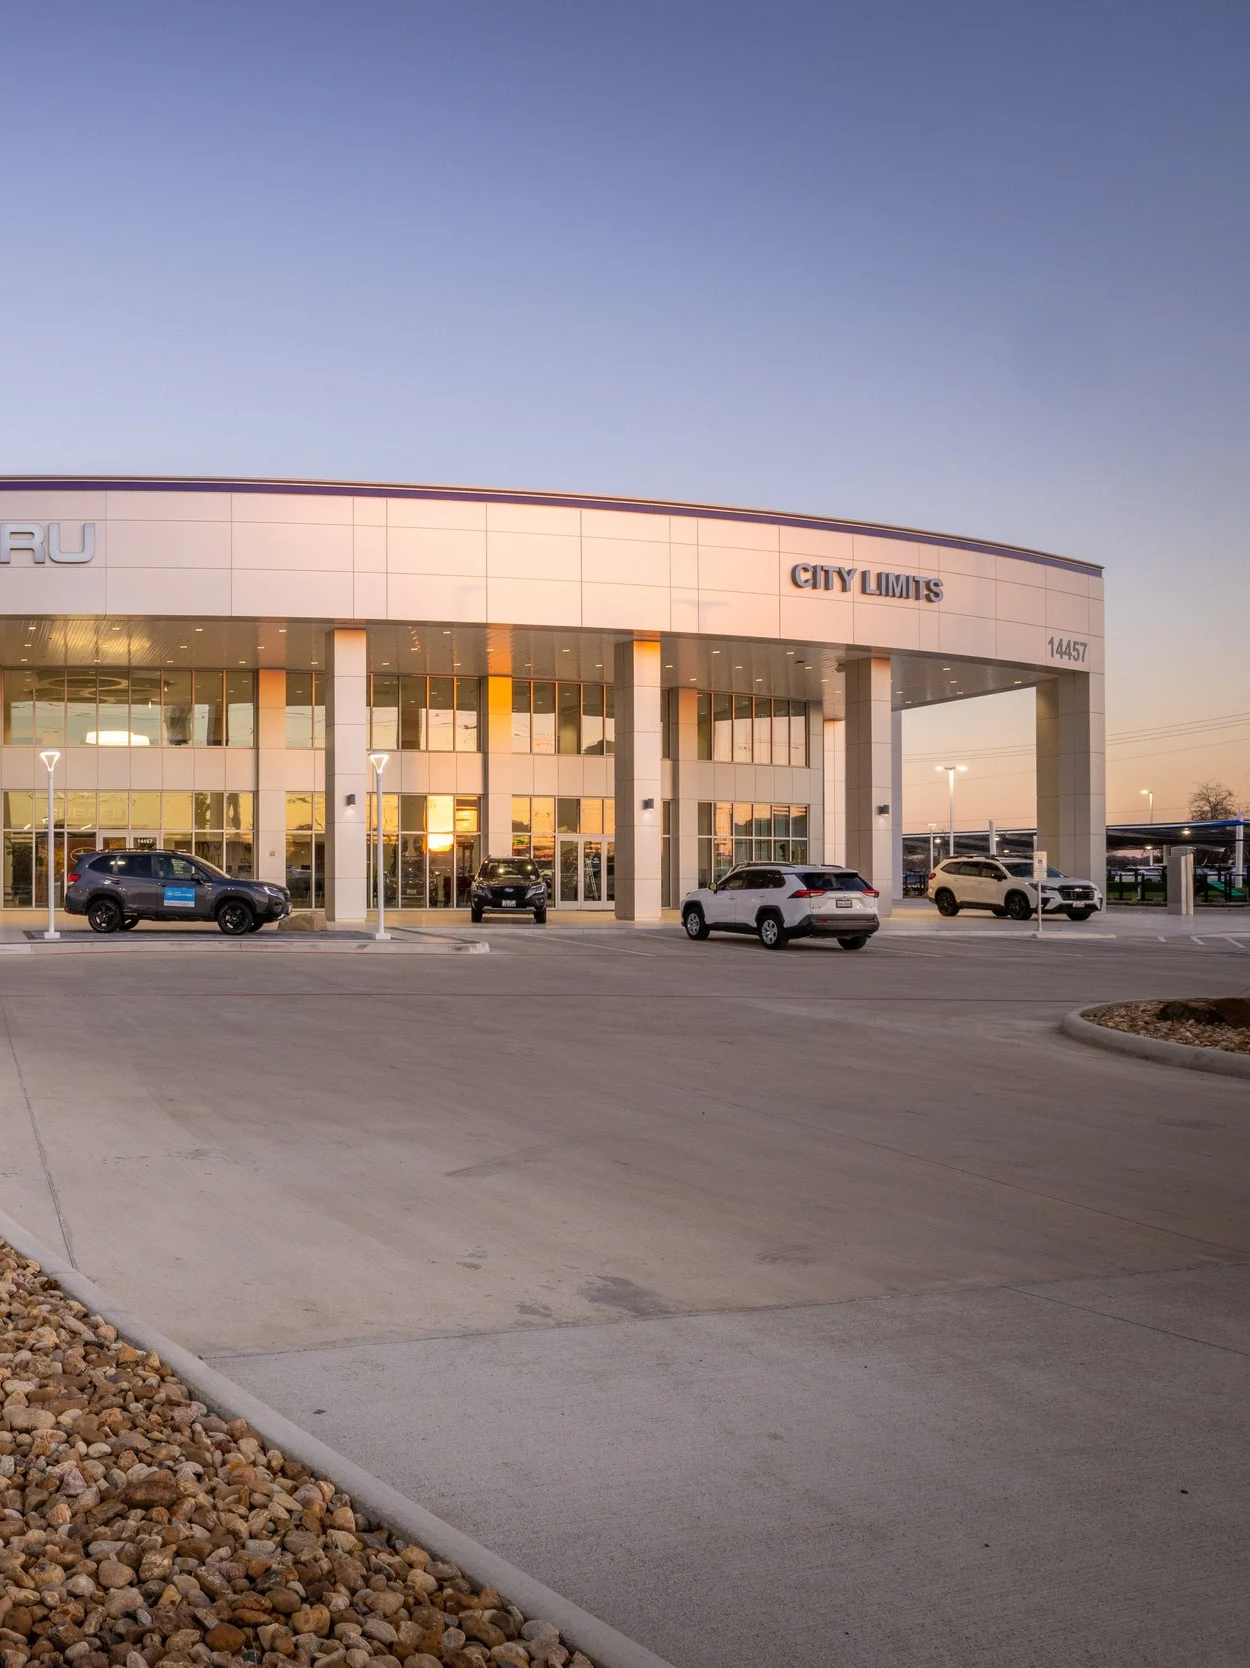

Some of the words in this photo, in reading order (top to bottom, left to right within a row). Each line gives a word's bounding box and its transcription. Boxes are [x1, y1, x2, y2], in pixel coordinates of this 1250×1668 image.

[791, 562, 857, 593] CITY
[861, 569, 944, 603] LIMITS
[1048, 636, 1088, 663] 14457
